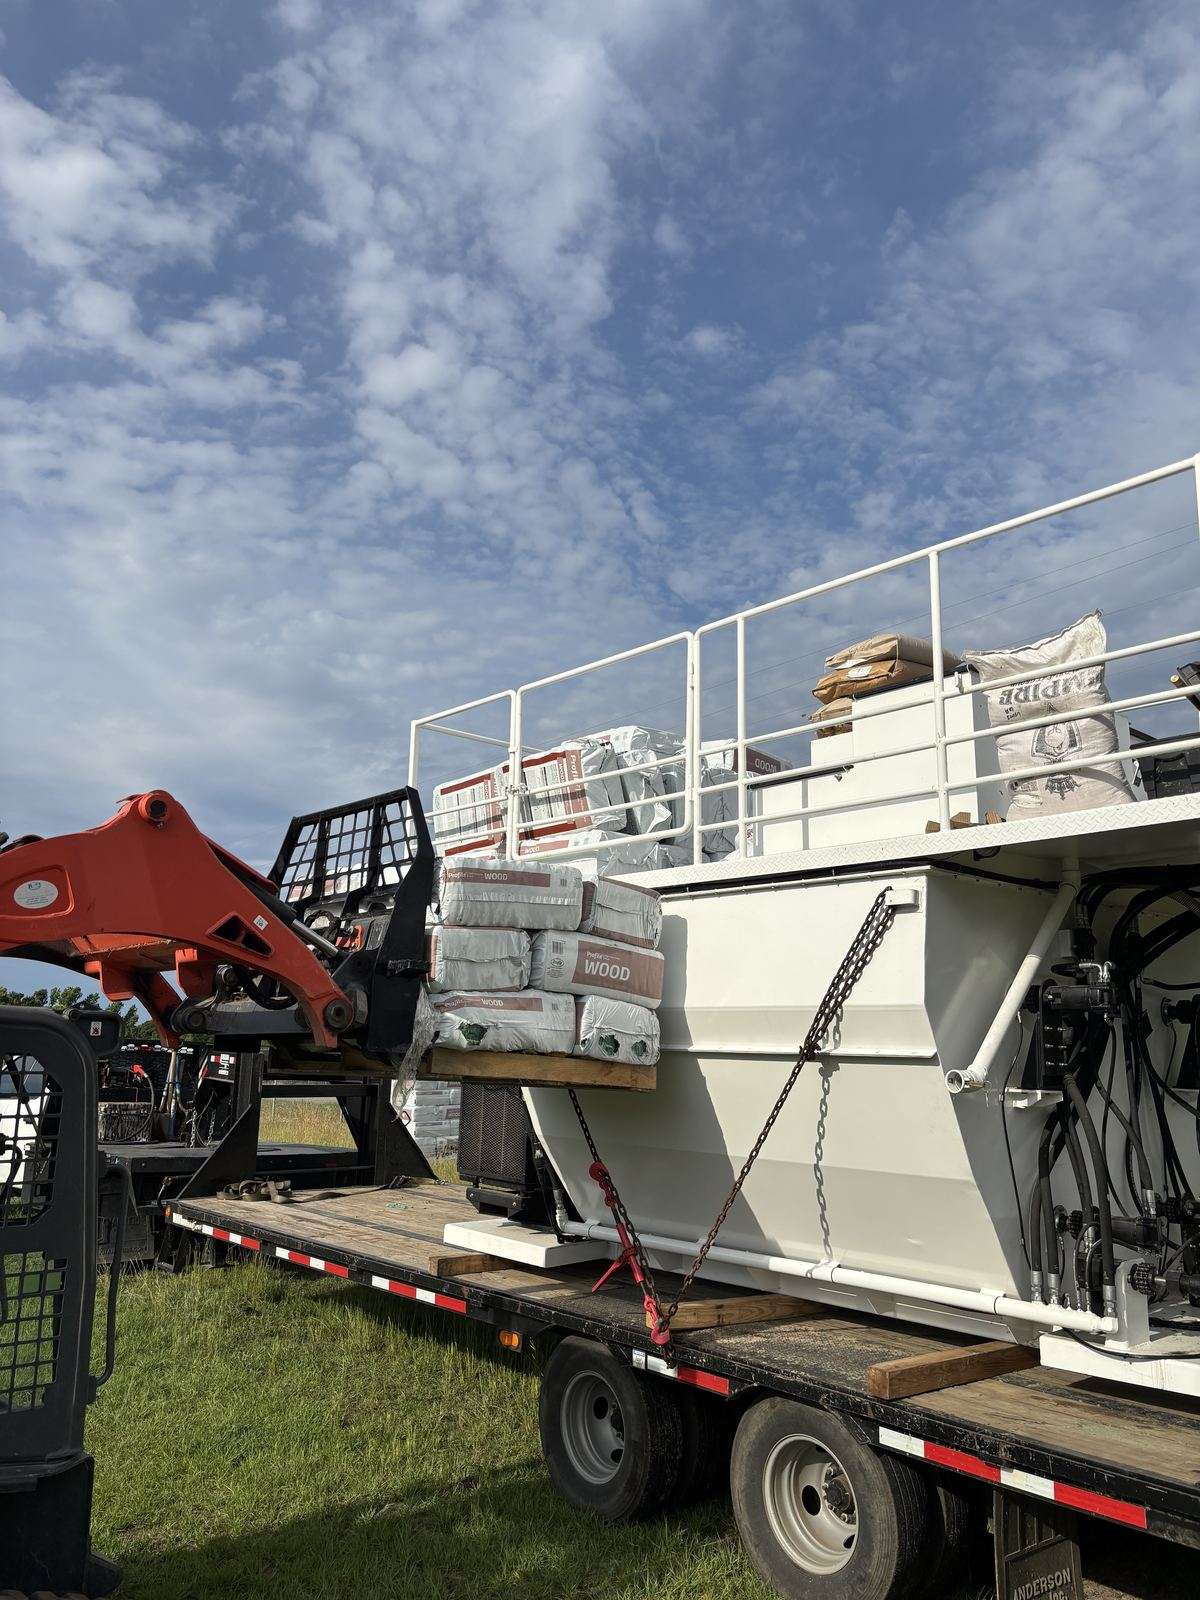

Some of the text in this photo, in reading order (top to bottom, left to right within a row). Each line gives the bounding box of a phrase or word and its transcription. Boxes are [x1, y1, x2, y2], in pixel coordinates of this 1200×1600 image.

[484, 871, 508, 881] WOOD
[584, 958, 631, 981] WOOD
[1013, 1567, 1071, 1600] ANDERSON
